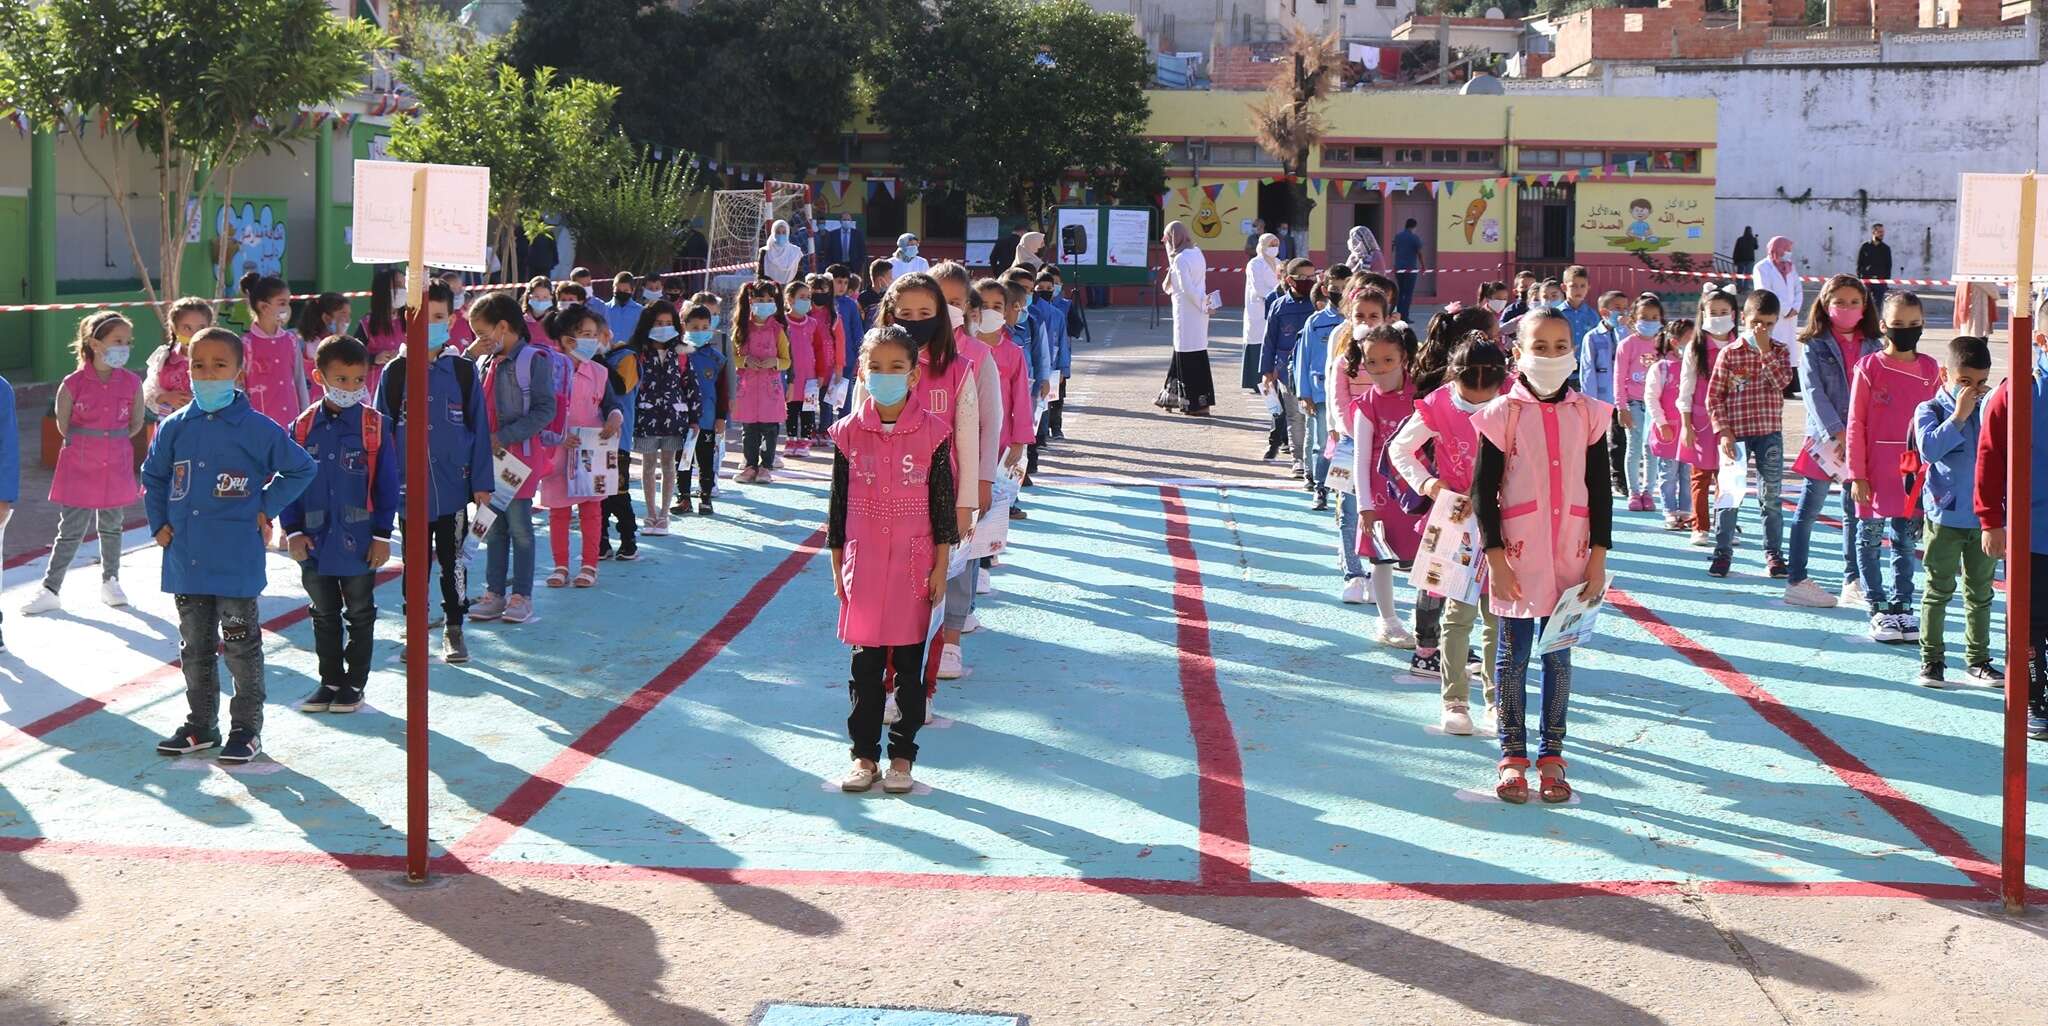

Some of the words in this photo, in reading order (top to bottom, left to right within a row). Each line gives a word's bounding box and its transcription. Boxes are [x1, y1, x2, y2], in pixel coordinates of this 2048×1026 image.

[1675, 214, 1705, 229] بسم
[929, 388, 948, 414] D
[902, 454, 914, 474] S
[216, 472, 249, 491] Day
